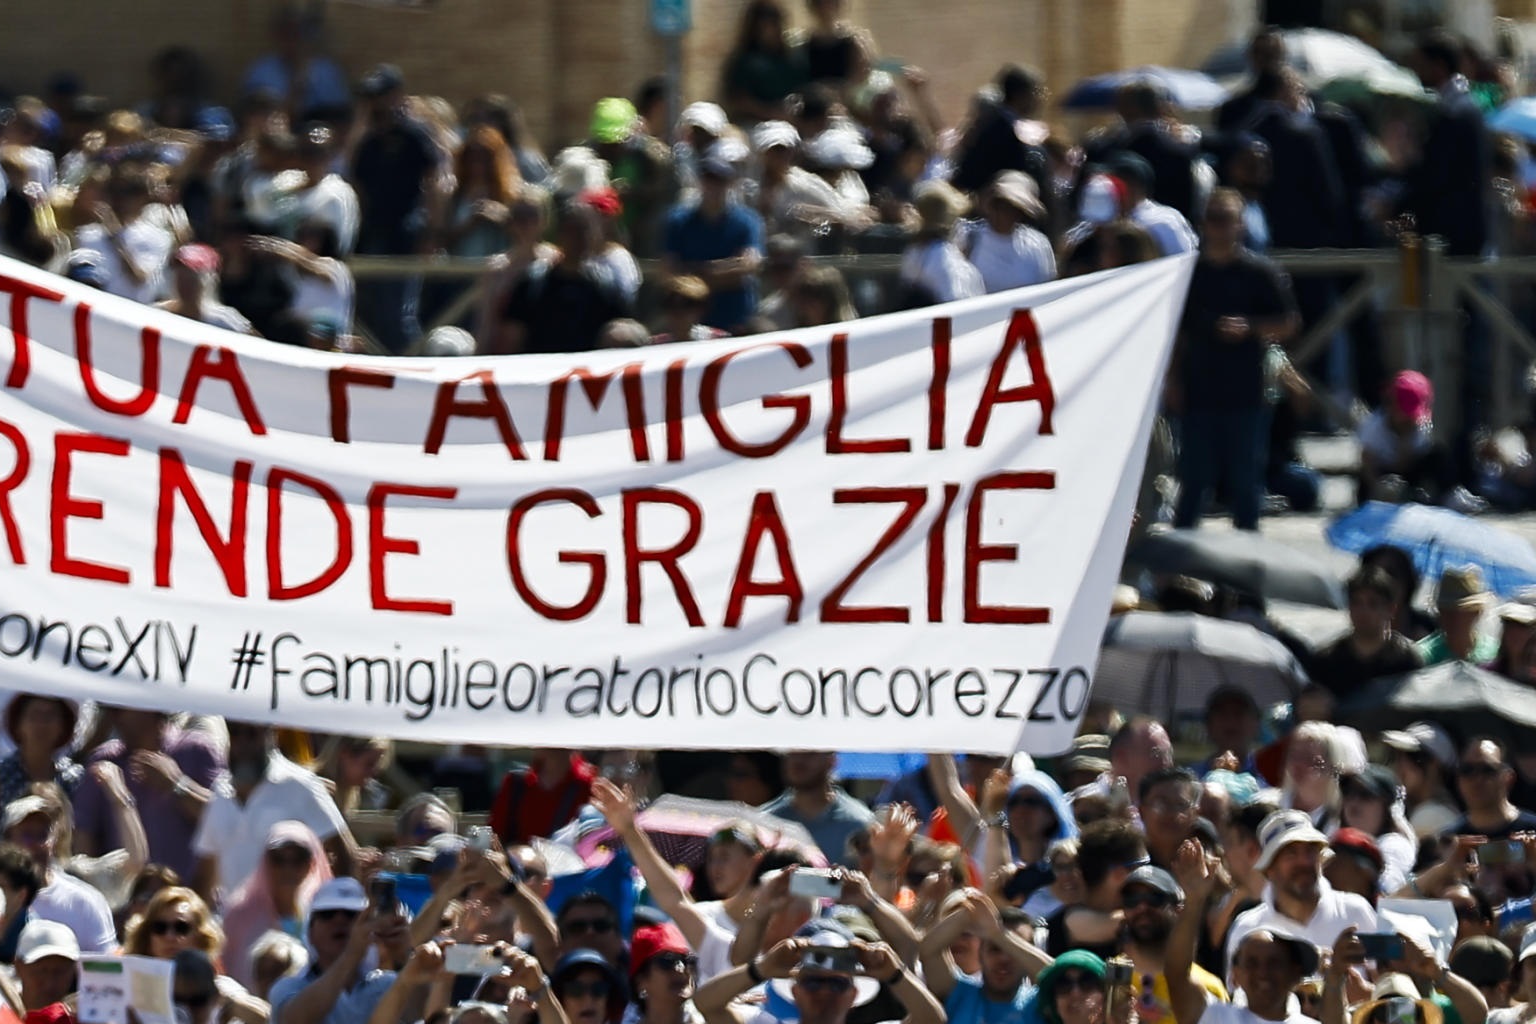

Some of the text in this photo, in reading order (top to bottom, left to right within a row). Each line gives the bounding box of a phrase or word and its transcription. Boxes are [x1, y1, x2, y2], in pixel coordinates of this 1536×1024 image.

[328, 307, 1056, 461] FAMIGLIA
[506, 471, 1056, 628] GRAZIE
[230, 631, 1092, 724] #famiglieoratorioConcorezzo
